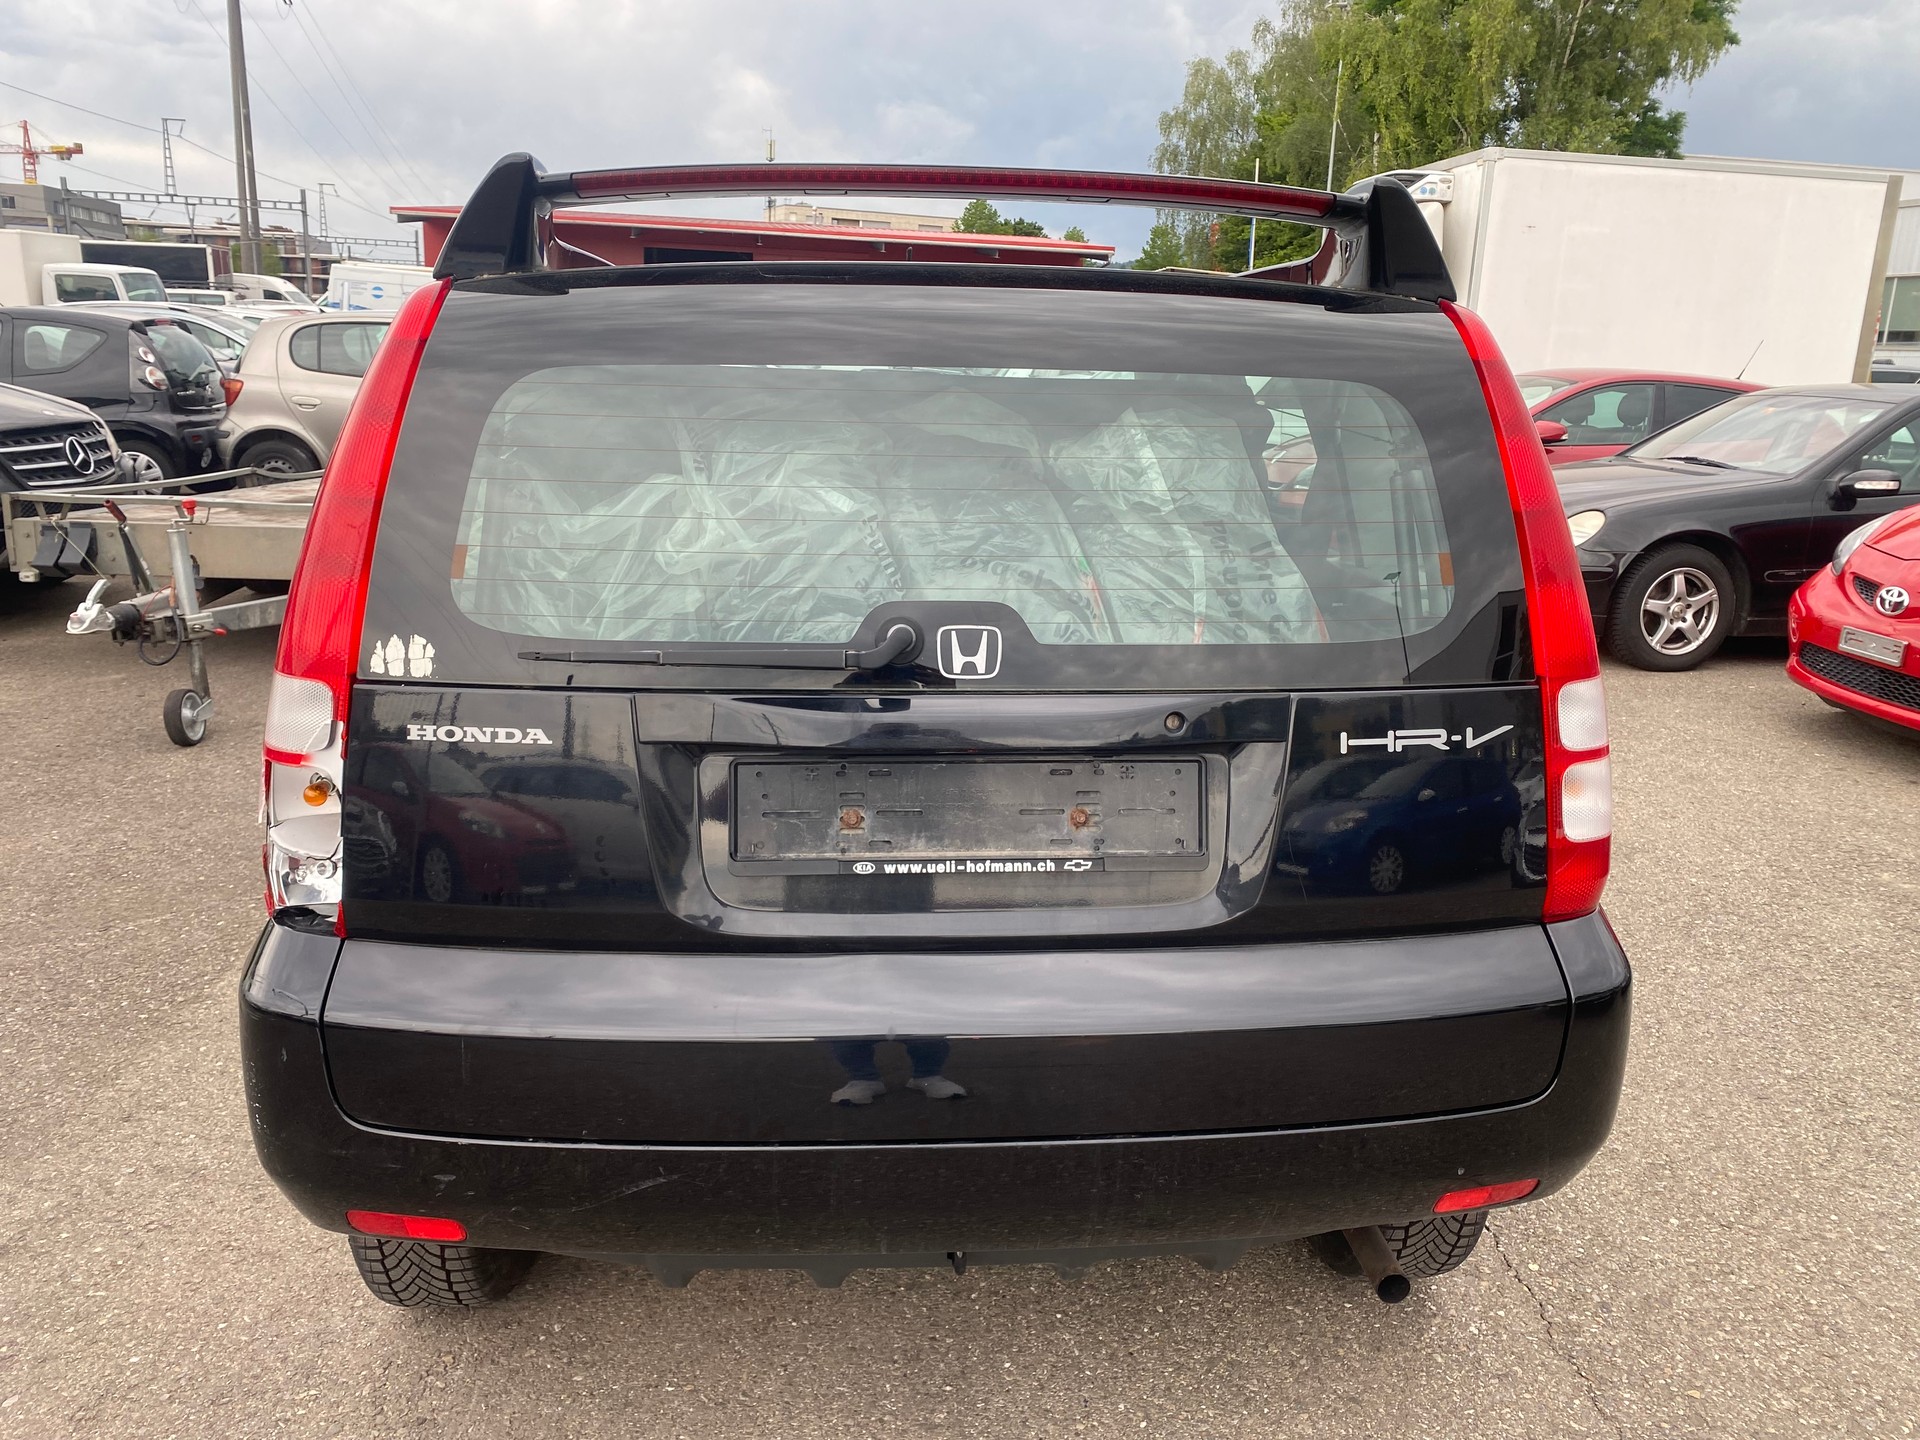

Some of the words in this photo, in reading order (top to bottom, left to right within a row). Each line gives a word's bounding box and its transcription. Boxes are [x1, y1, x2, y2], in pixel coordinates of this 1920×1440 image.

[406, 724, 553, 745] HONDA
[1339, 724, 1515, 755] HR-V
[883, 860, 1056, 874] www.ueli-hofmann.ch
